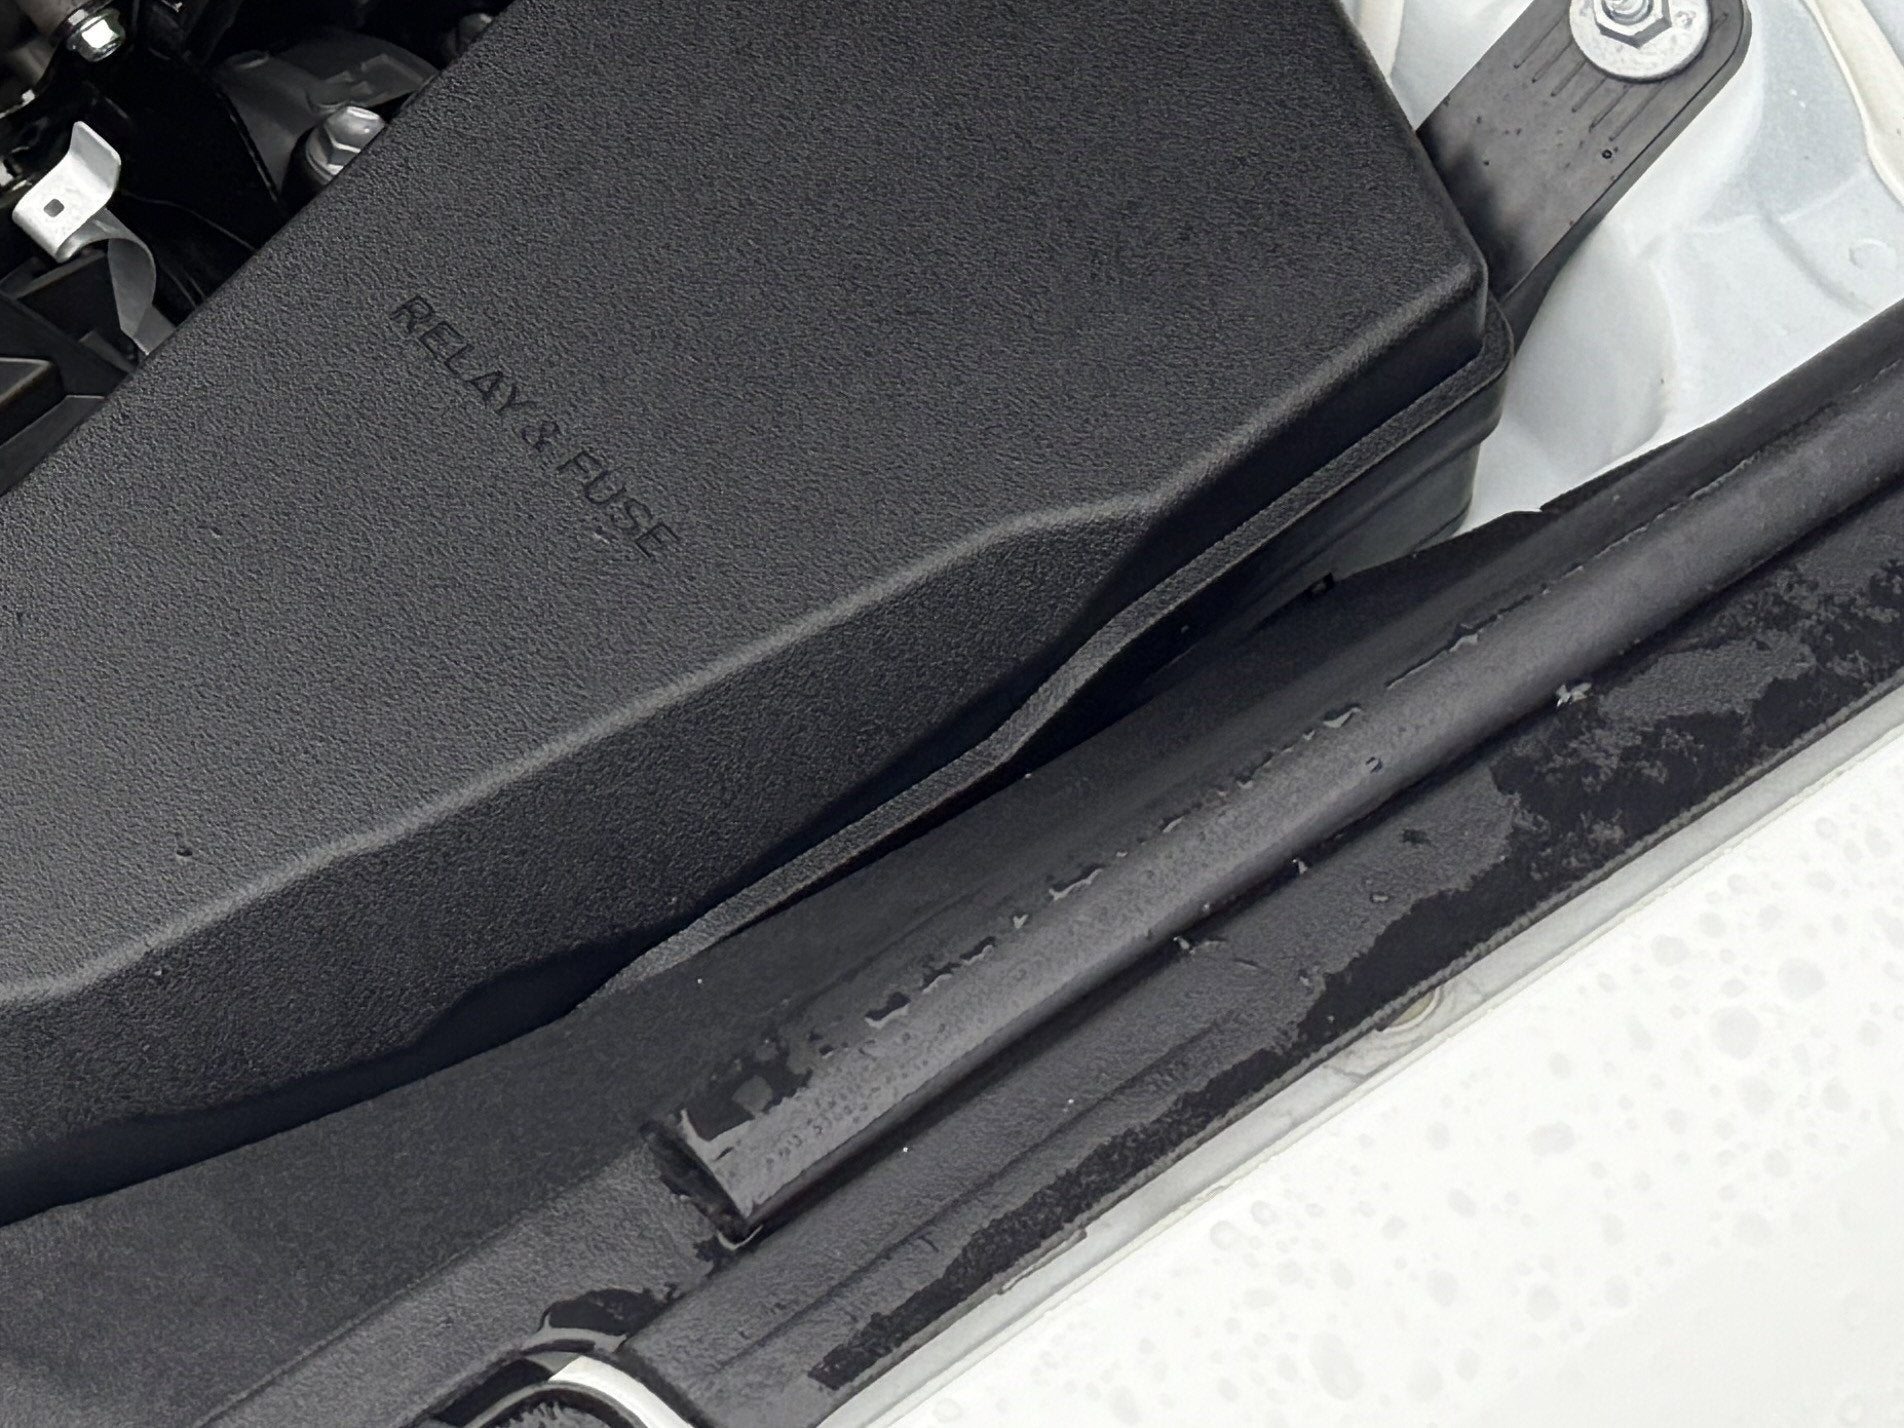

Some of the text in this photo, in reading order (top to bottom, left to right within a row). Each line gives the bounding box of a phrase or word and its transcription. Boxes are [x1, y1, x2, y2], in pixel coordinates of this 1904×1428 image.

[390, 294, 684, 560] RELAY & FUSE
